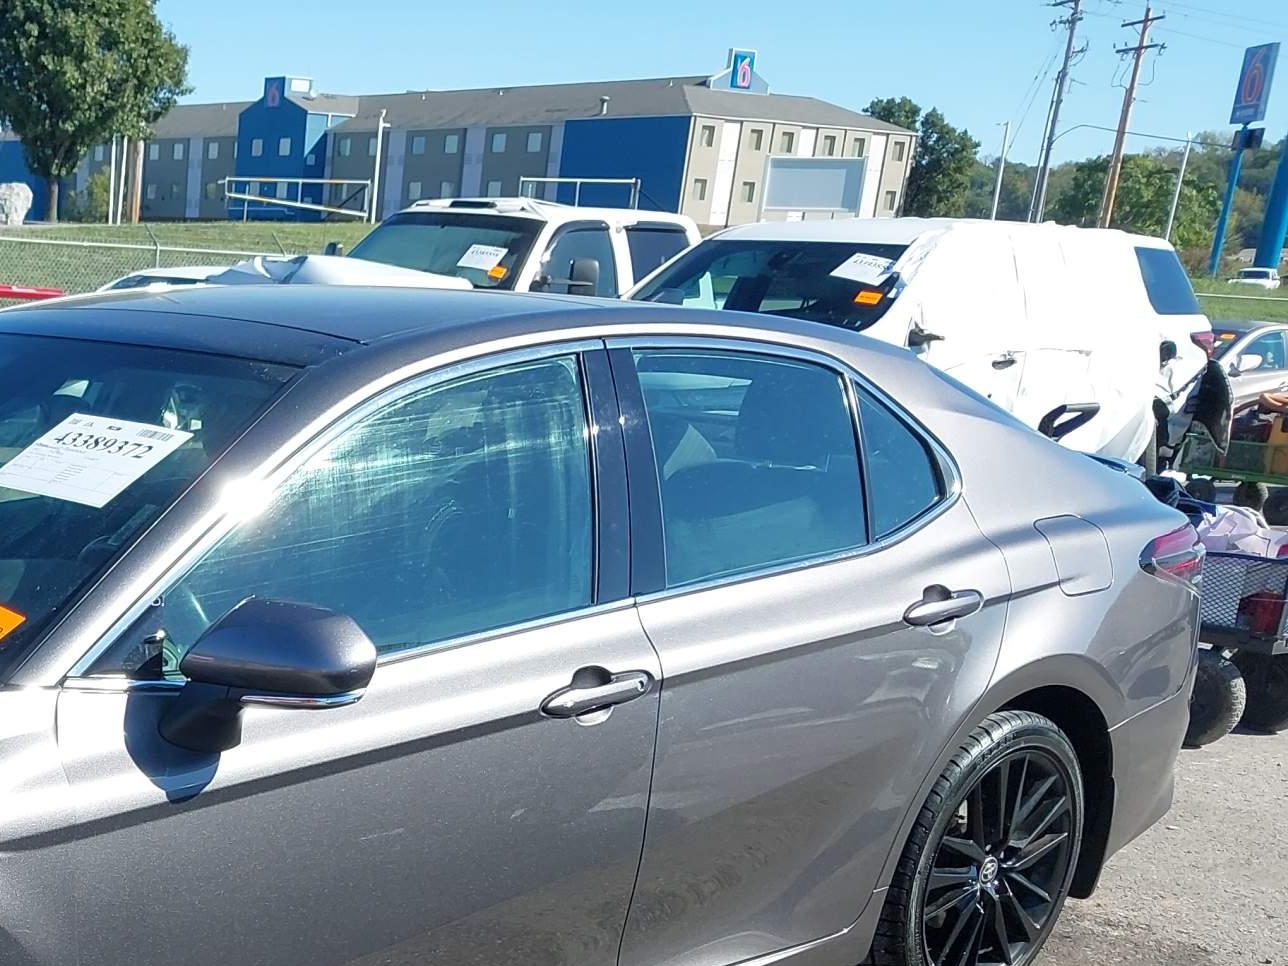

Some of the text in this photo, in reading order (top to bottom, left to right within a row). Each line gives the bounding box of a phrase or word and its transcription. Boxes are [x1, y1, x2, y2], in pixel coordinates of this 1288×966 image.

[737, 56, 751, 88] 6
[1241, 47, 1267, 105] 6
[267, 80, 280, 107] 6
[54, 431, 154, 459] 43389372
